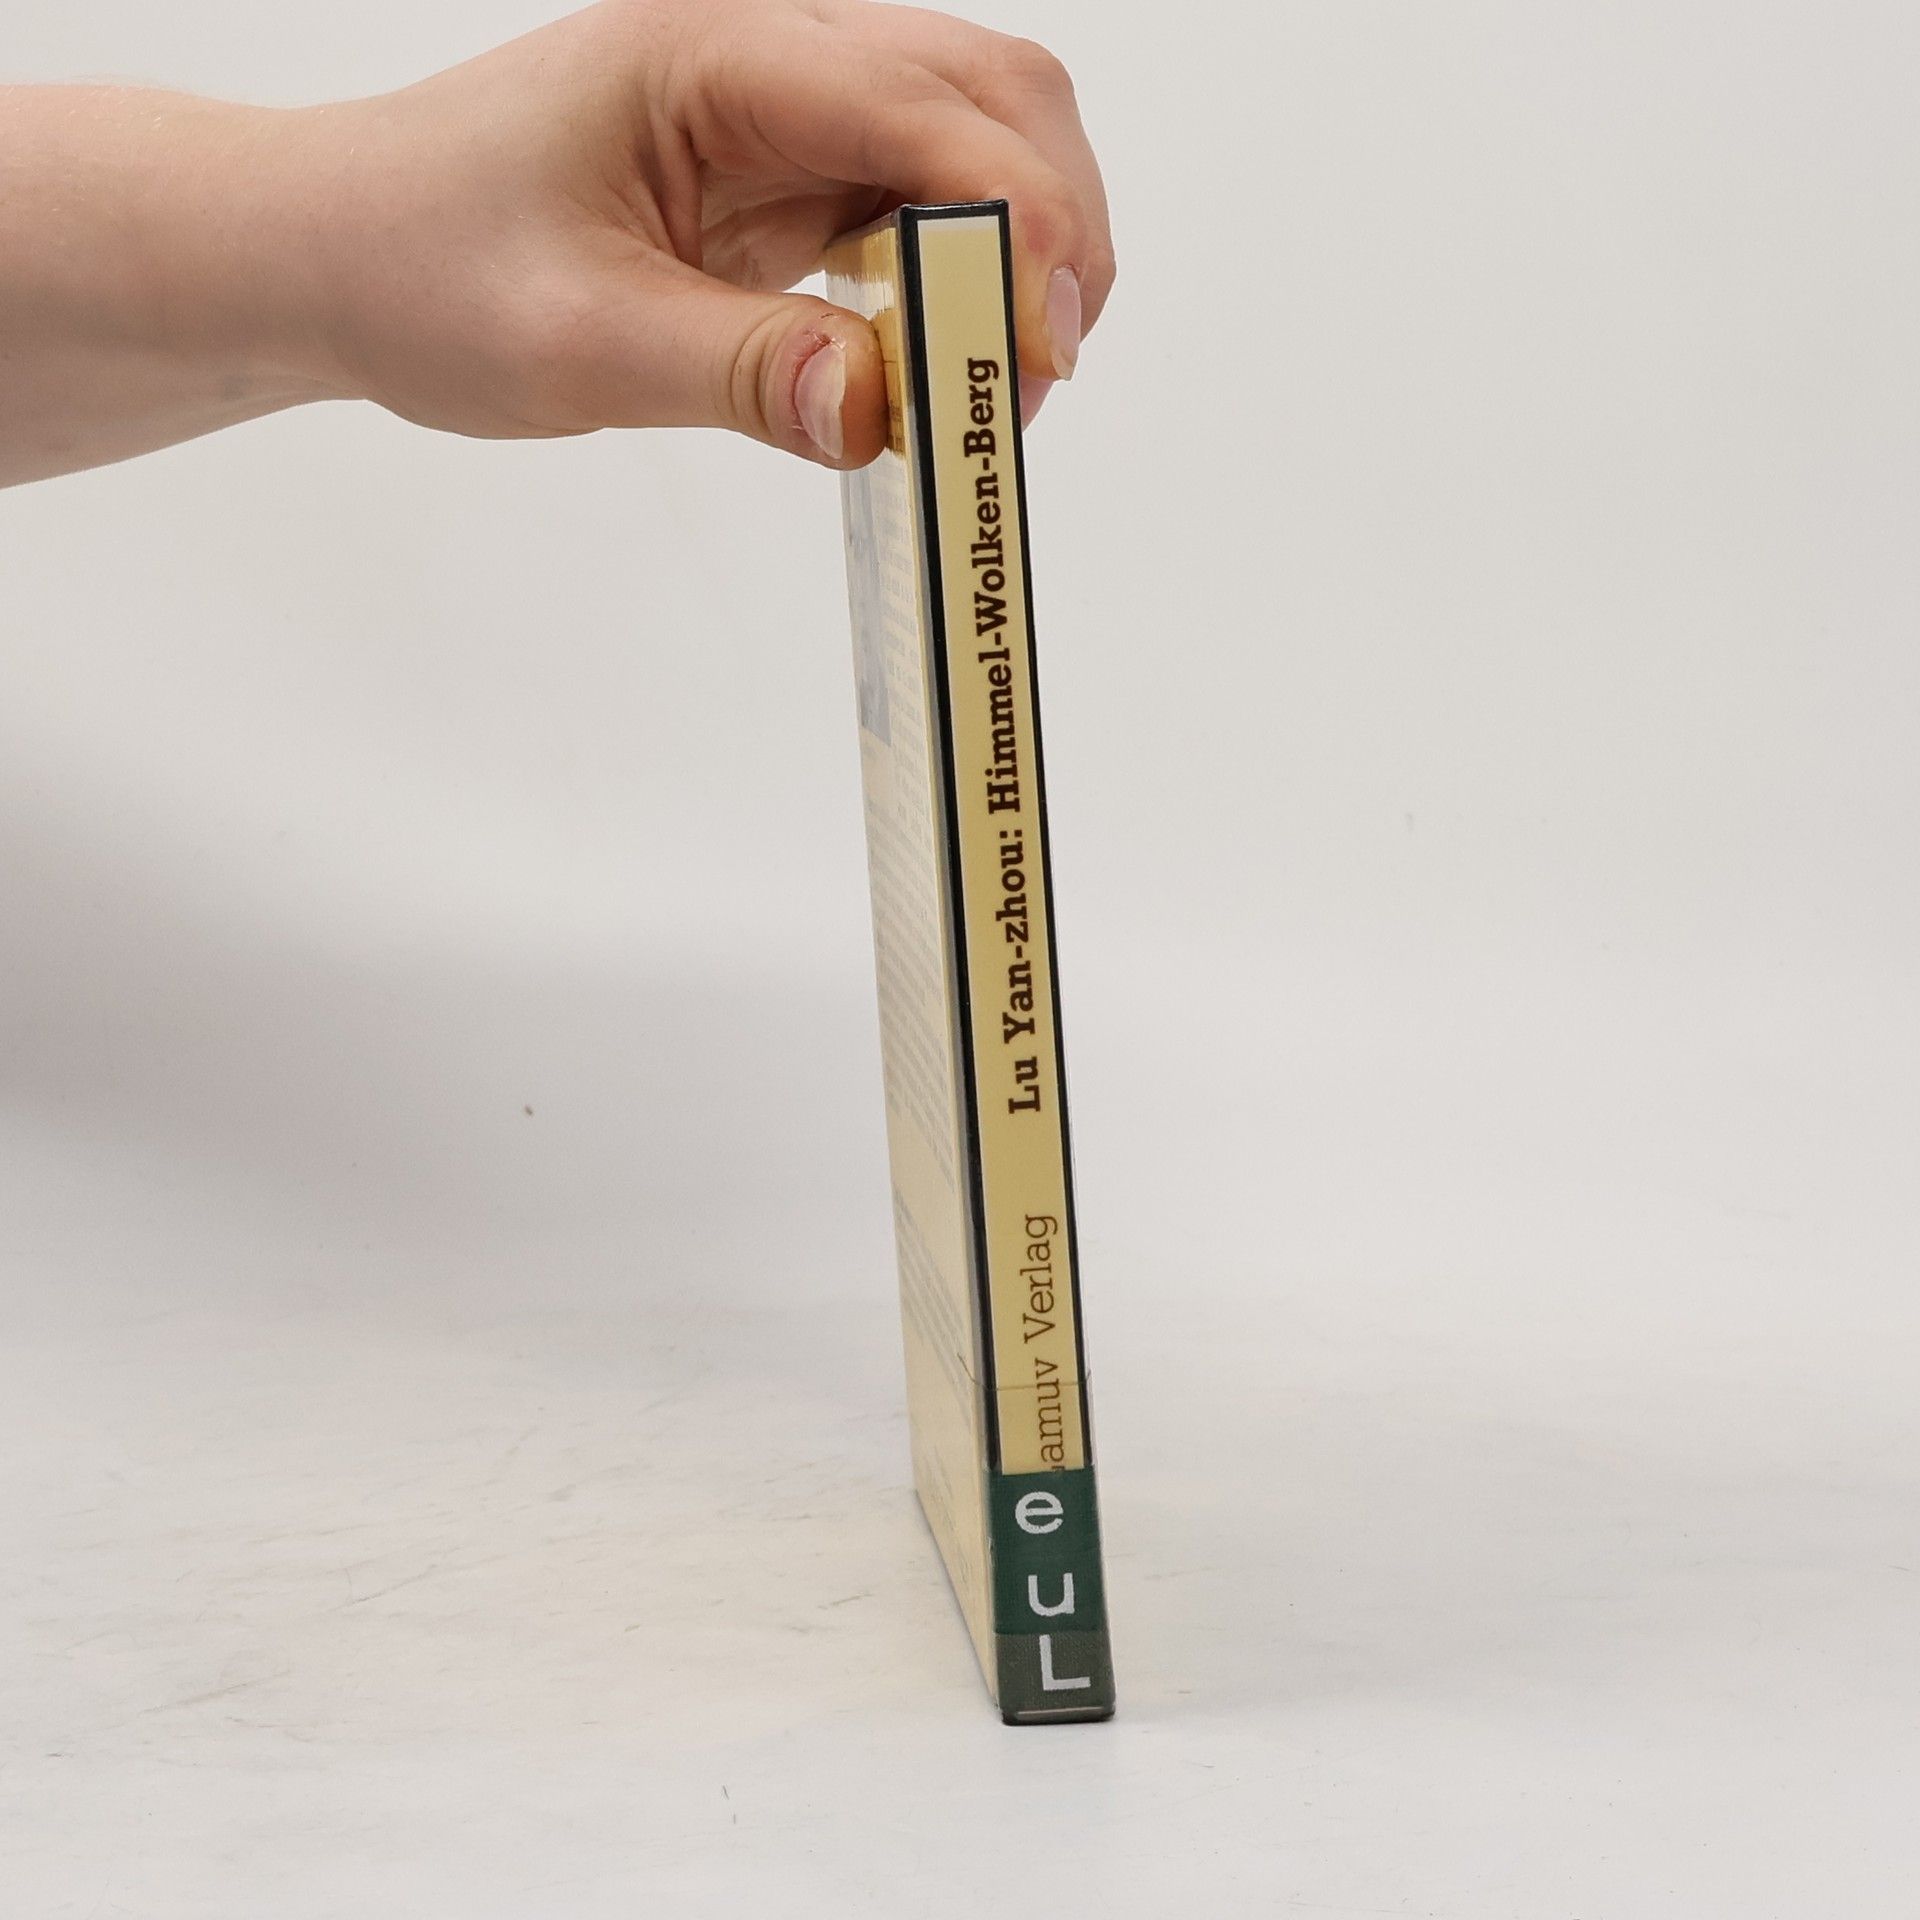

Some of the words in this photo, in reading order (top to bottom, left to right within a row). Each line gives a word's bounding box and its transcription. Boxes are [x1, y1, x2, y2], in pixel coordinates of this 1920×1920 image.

[962, 357, 1021, 816] Himmel-Wolken-Berg
[995, 828, 1036, 1045] Yan-zhou:
[1007, 1055, 1042, 1115] Lu
[1019, 1213, 1059, 1345] Verlag
[1034, 1357, 1066, 1473] amuv
